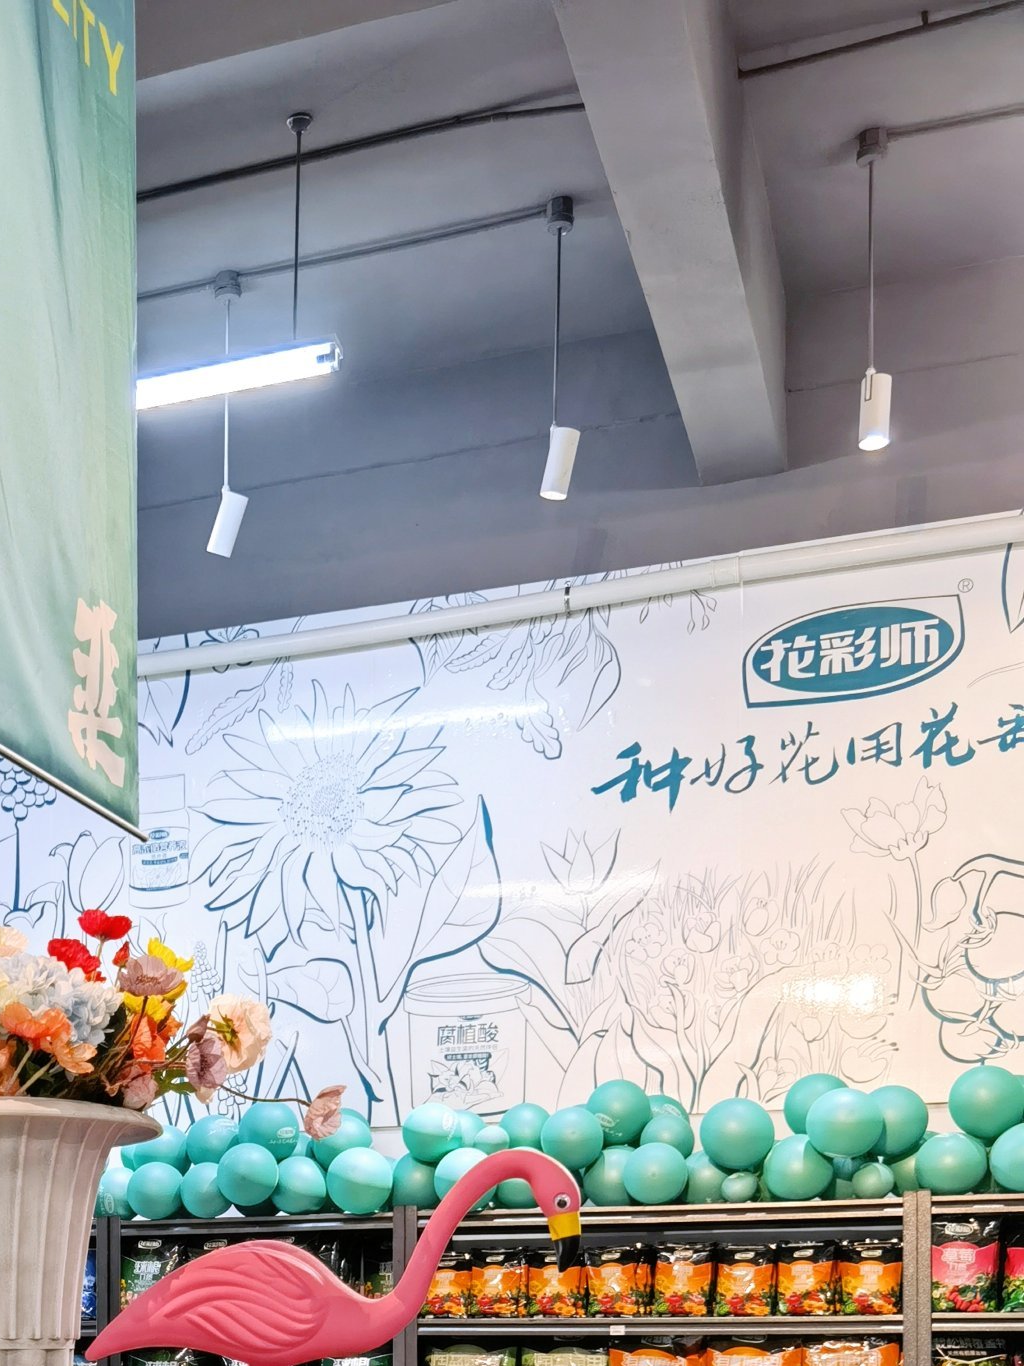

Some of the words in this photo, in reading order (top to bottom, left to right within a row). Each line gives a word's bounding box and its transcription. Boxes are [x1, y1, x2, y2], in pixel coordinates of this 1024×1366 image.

[761, 618, 940, 682] 花彩师
[437, 1022, 499, 1046] 腐植酸
